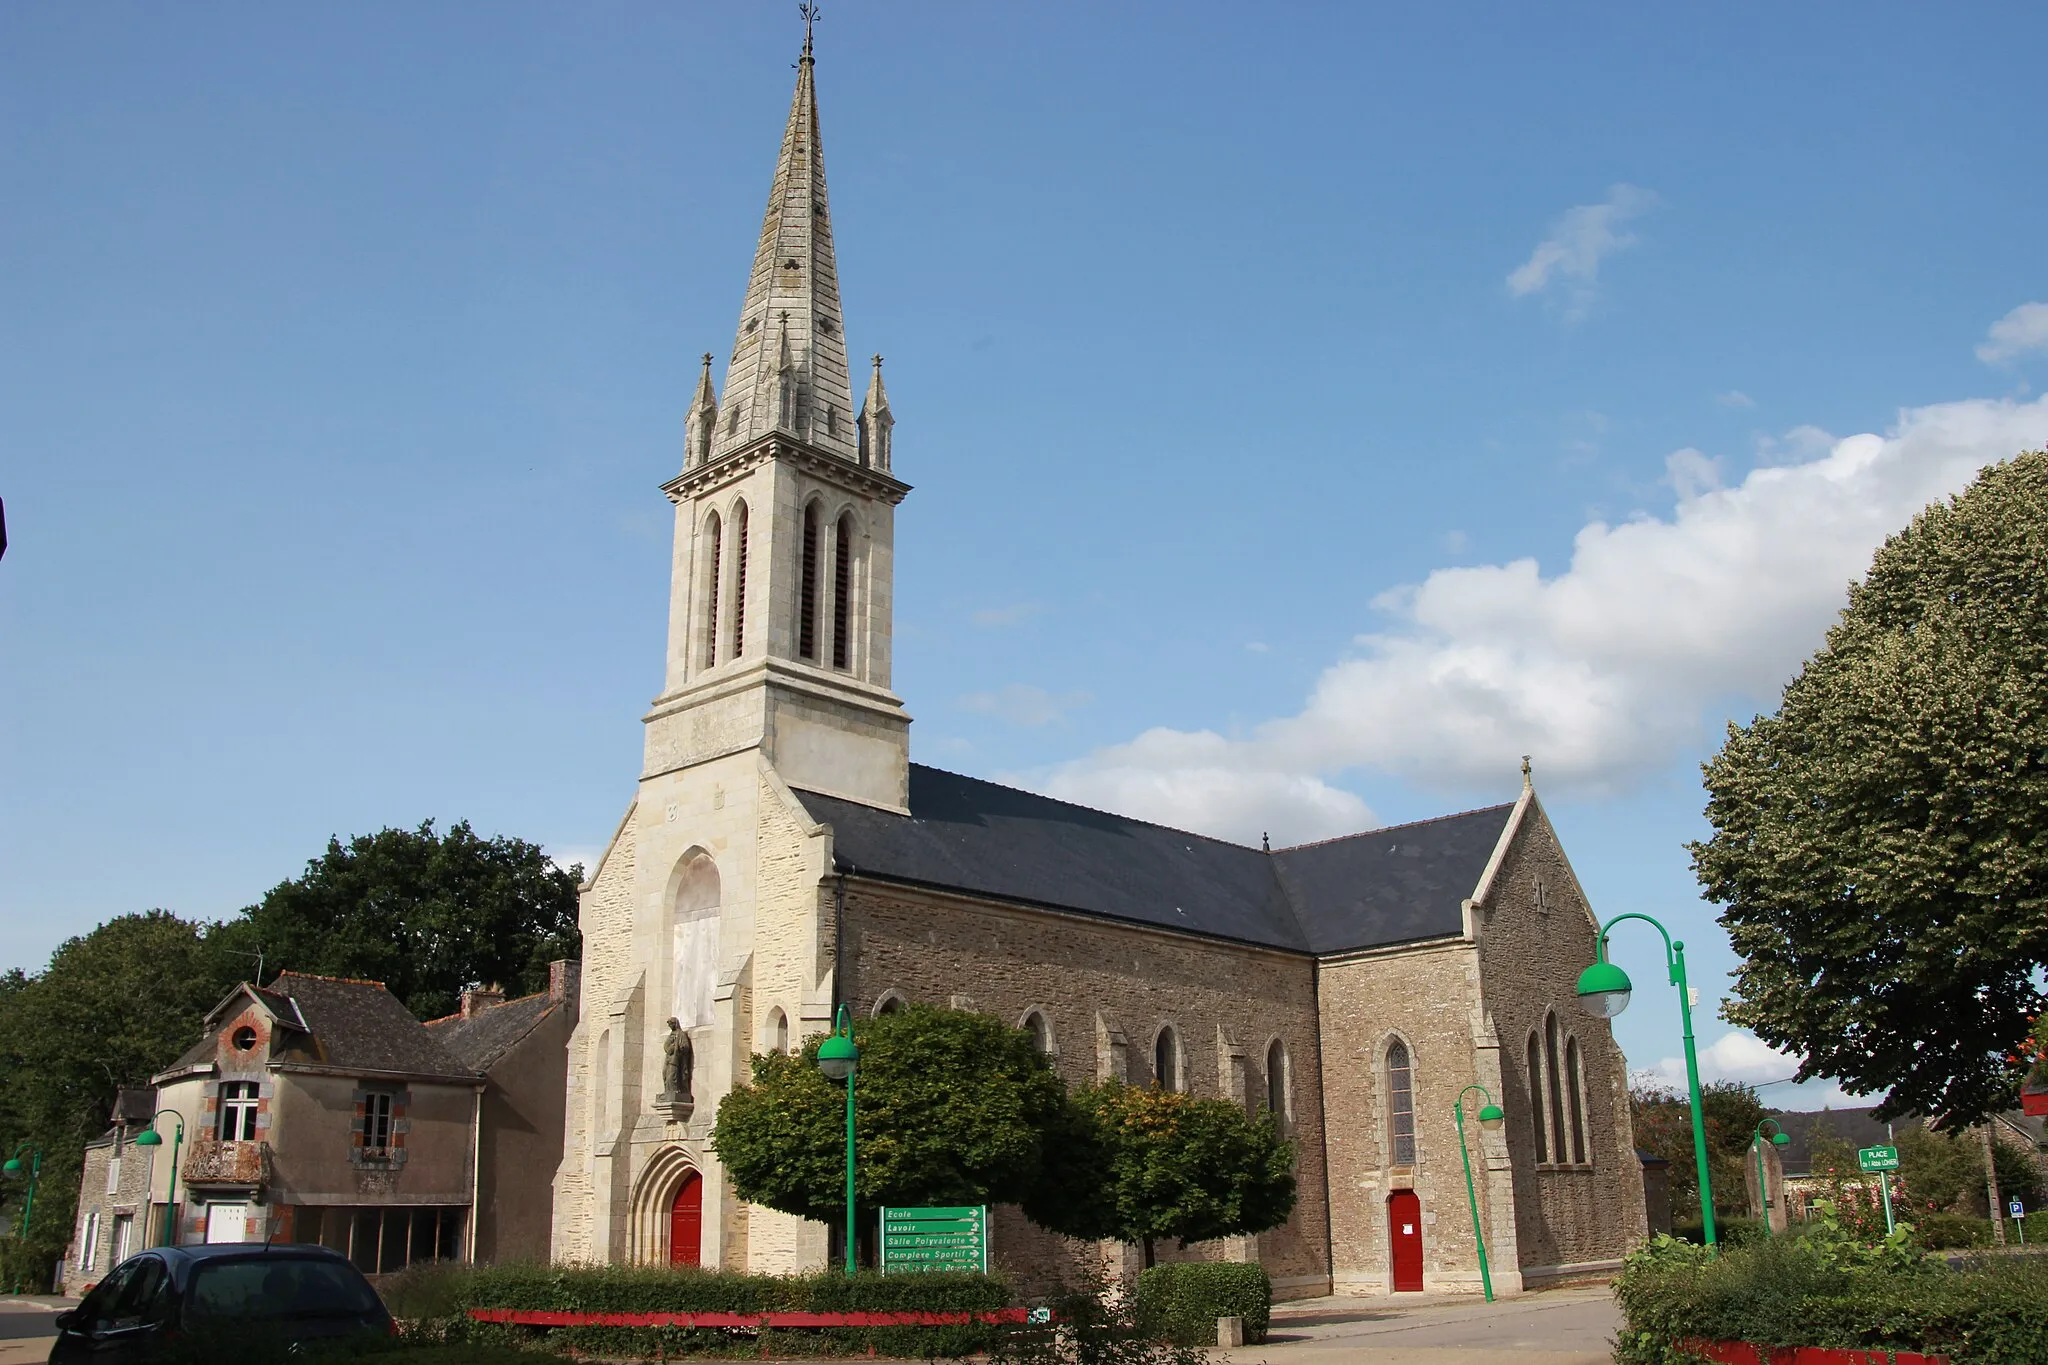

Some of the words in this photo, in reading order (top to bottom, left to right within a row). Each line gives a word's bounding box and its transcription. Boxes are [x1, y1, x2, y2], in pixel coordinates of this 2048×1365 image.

[888, 1210, 912, 1218] Ecole
[887, 1224, 916, 1232] Lavoir
[888, 1237, 911, 1245] Salle
[915, 1237, 966, 1246] Polyvalente
[888, 1251, 930, 1260] Complexe
[935, 1250, 966, 1259] Sportif
